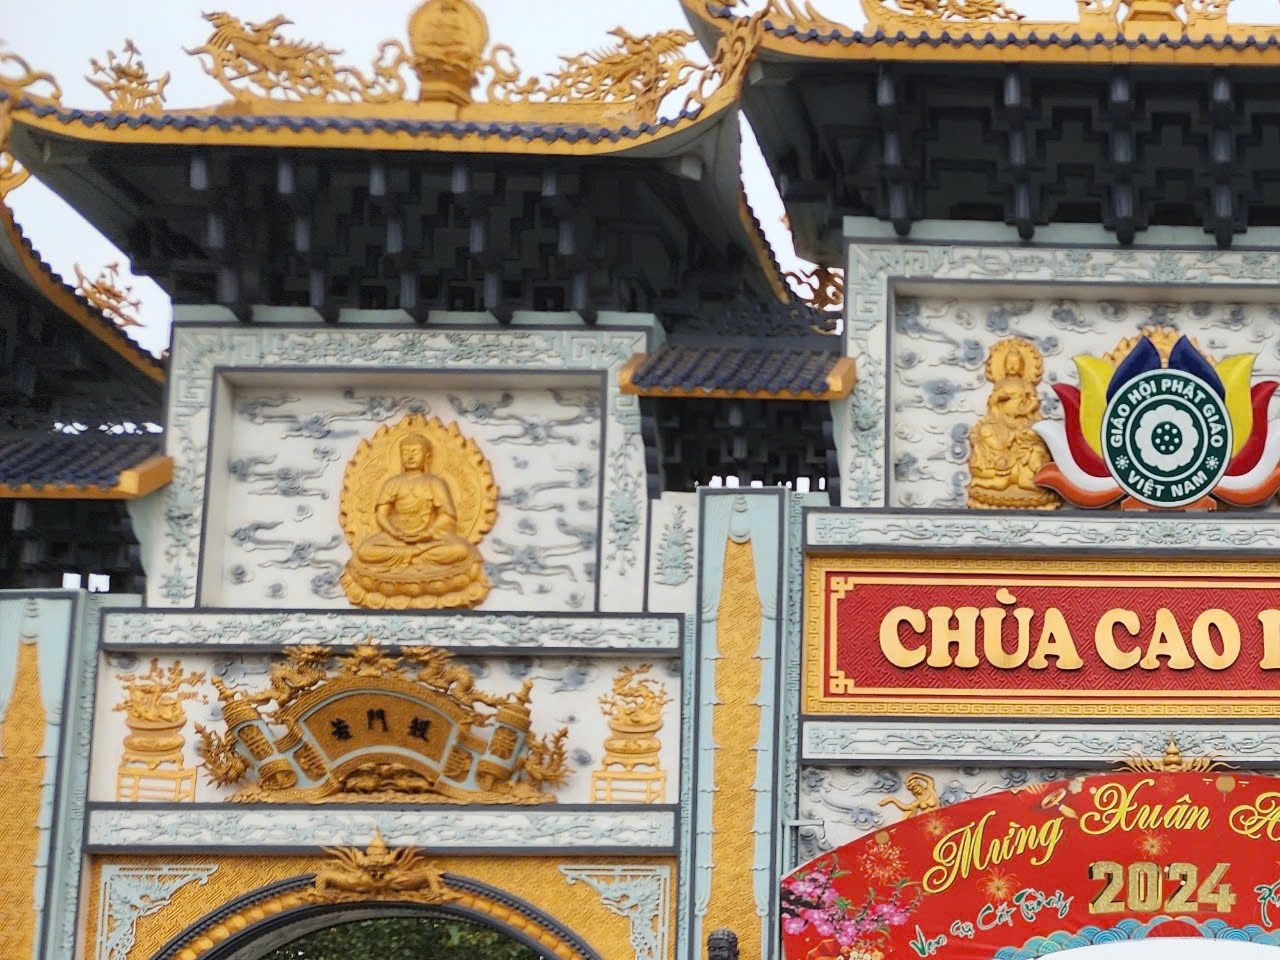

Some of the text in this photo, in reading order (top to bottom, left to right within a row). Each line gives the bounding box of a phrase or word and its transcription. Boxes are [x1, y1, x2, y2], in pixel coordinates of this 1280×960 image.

[1110, 378, 1224, 448] GIÁO HỘI PHẬT GIÁO
[1127, 469, 1208, 498] VIỆT NAM
[879, 587, 1084, 670] CHÙA
[1095, 607, 1241, 671] CAO
[922, 810, 1065, 893] Mừng
[1080, 778, 1210, 835] Xuân
[1088, 861, 1237, 914] 2024
